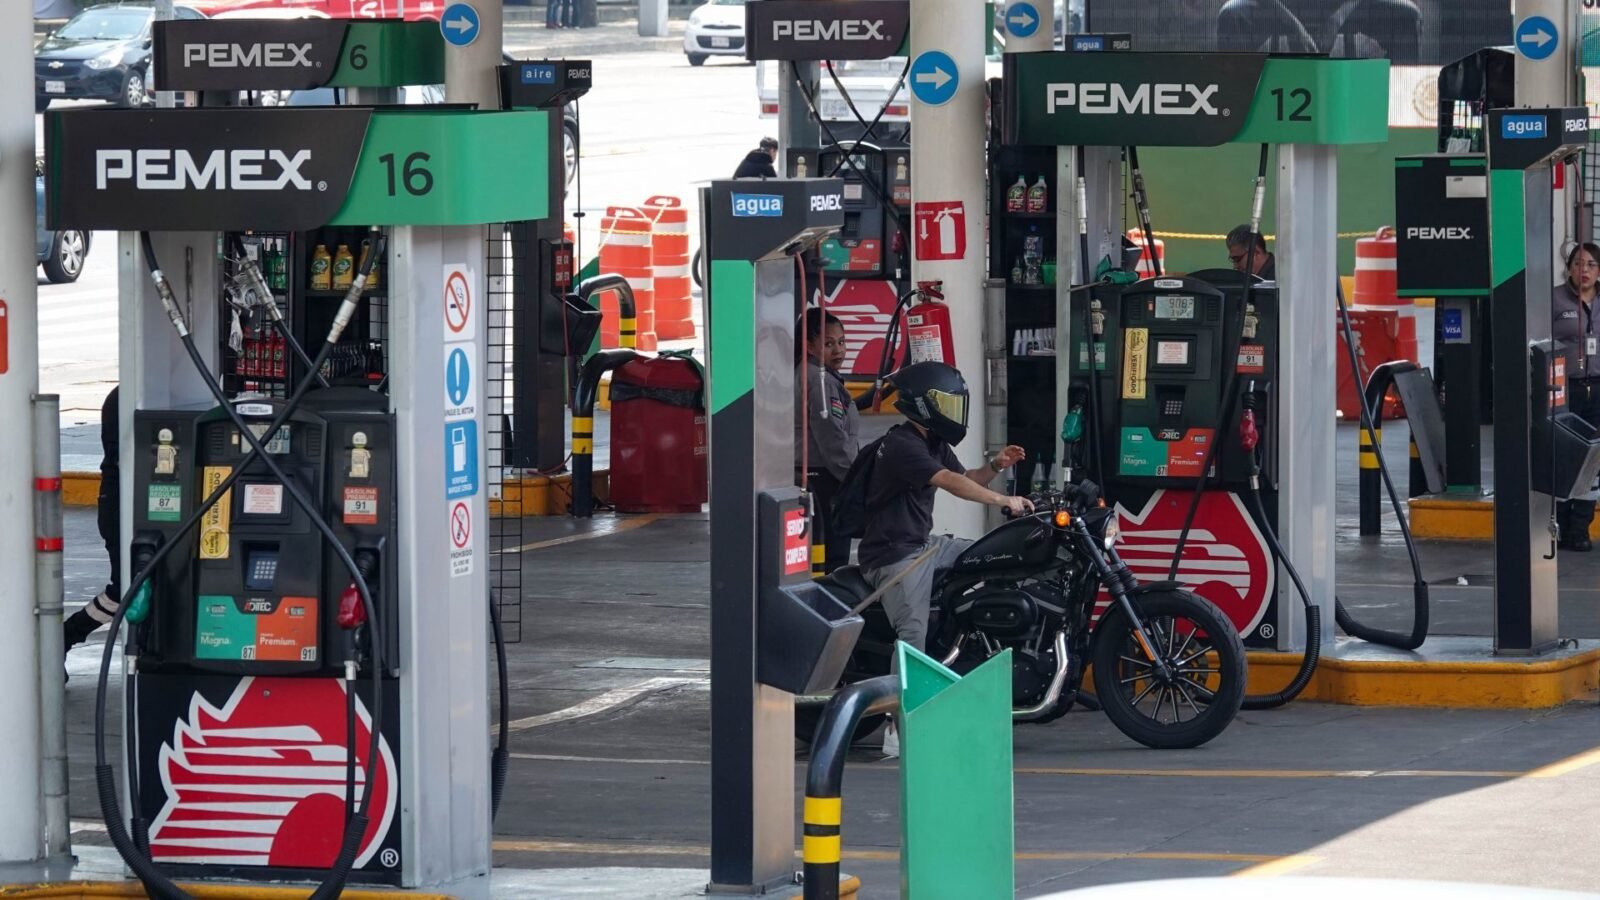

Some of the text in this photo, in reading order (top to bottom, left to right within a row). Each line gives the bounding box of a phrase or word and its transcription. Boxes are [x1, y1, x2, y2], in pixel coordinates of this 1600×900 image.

[773, 20, 883, 40] PEMEX
[1077, 41, 1099, 50] agua
[184, 43, 312, 67] PEMEX
[350, 45, 368, 70] 6
[526, 68, 552, 78] aire
[568, 69, 590, 78] PEMEX
[1047, 83, 1218, 115] PEMEX
[1270, 88, 1312, 122] 12
[1507, 121, 1542, 134] agua
[1565, 119, 1587, 132] PEMEX
[96, 149, 312, 190] PEMEX
[378, 151, 434, 196] 16
[736, 198, 780, 214] agua
[811, 194, 841, 211] PEMEX
[1407, 227, 1471, 239] PEMEX
[1445, 326, 1461, 334] VISA
[1124, 457, 1147, 466] Magna
[159, 498, 170, 507] 87
[355, 501, 366, 510] 91
[201, 636, 296, 646] Magna Premium
